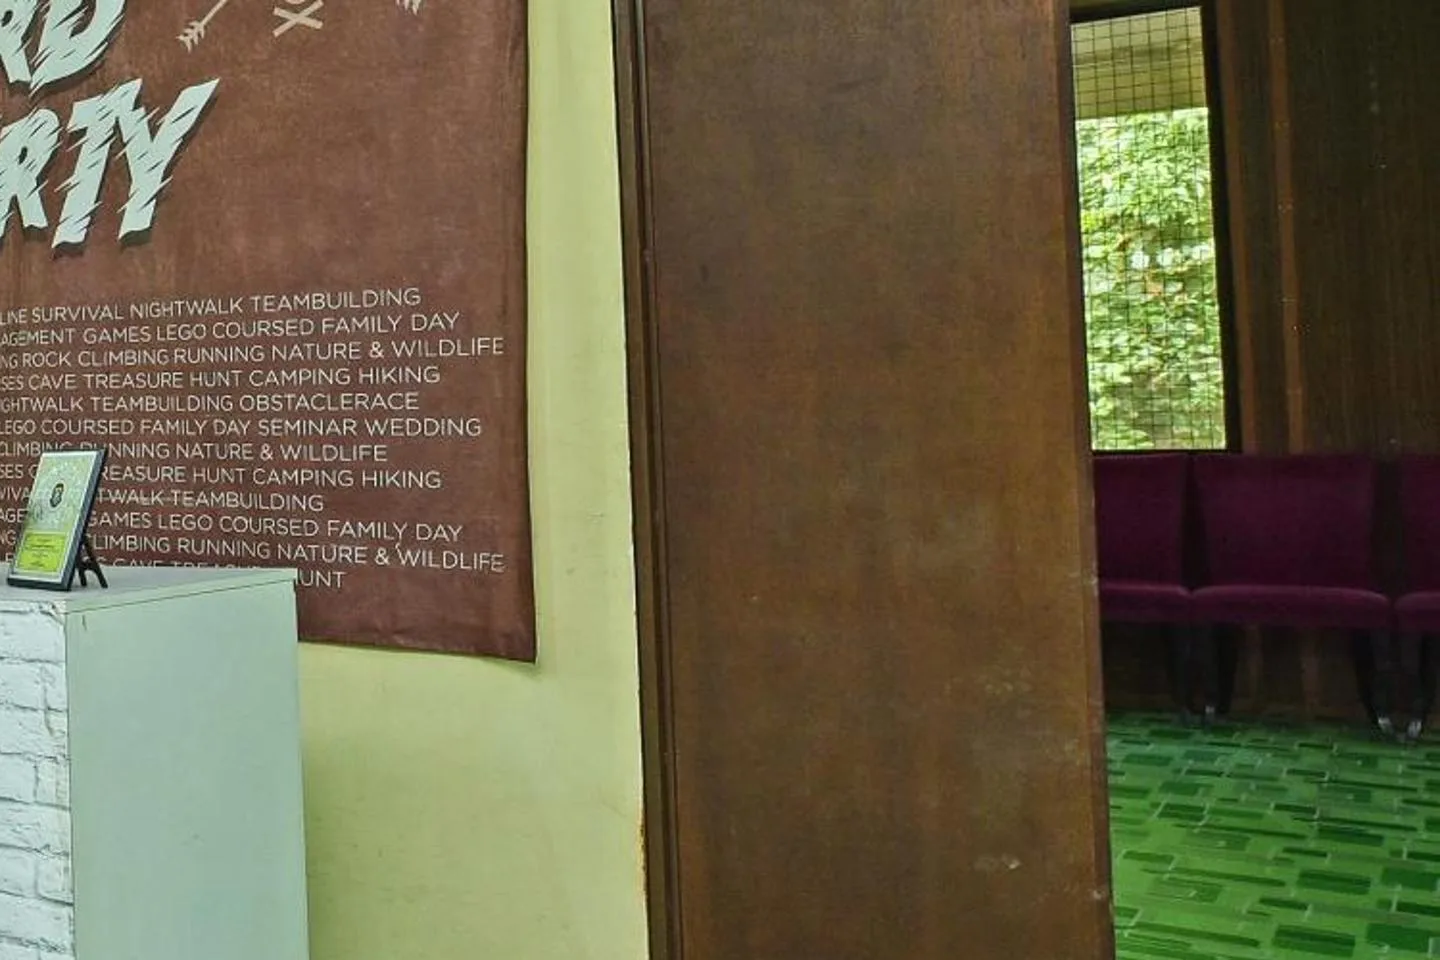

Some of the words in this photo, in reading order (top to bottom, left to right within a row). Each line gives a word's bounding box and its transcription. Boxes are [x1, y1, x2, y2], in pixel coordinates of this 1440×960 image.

[32, 302, 124, 325] SURVIVAL
[130, 296, 243, 320] NIGHTWALK
[250, 287, 422, 313] TEAMBUILDING
[82, 325, 152, 345] GAMES
[156, 322, 207, 342] LEGO
[212, 318, 314, 340] COURSED
[322, 314, 402, 335] FAMILY
[412, 311, 460, 332] DAY
[22, 350, 72, 369] ROCK
[78, 348, 170, 368] CLIMBING
[173, 344, 266, 365] RUNNING
[272, 341, 362, 362] NATURE
[369, 340, 384, 360] &
[391, 336, 504, 358] WILDLIFE
[28, 373, 76, 391] CAVE
[82, 371, 184, 391] TREASURE
[190, 369, 244, 388] HUNT
[248, 367, 350, 387] CAMPING
[358, 365, 442, 385] HIKING
[90, 394, 234, 414] TEAMBUILDING
[239, 392, 420, 412] OBSTACLERACE
[40, 418, 135, 435] COURSED
[139, 418, 208, 436] FAMILY
[213, 418, 251, 436] DAY
[258, 418, 358, 437] SEMINAR
[364, 417, 482, 437] WEDDING
[175, 442, 252, 461] NATURE
[260, 443, 274, 461] &
[280, 442, 388, 463] WILDLIFE
[193, 466, 245, 485] HUNT
[252, 467, 354, 487] CAMPING
[362, 469, 442, 489] HIKING
[171, 489, 324, 512] TEAMBUILDING
[158, 512, 214, 532] LEGO
[219, 515, 319, 537] COURSED
[328, 519, 408, 541] FAMILY
[416, 522, 464, 543] DAY
[178, 536, 271, 560] RUNNING
[277, 541, 368, 565] NATURE
[374, 546, 390, 566] &
[396, 548, 506, 572] WILDLIFE
